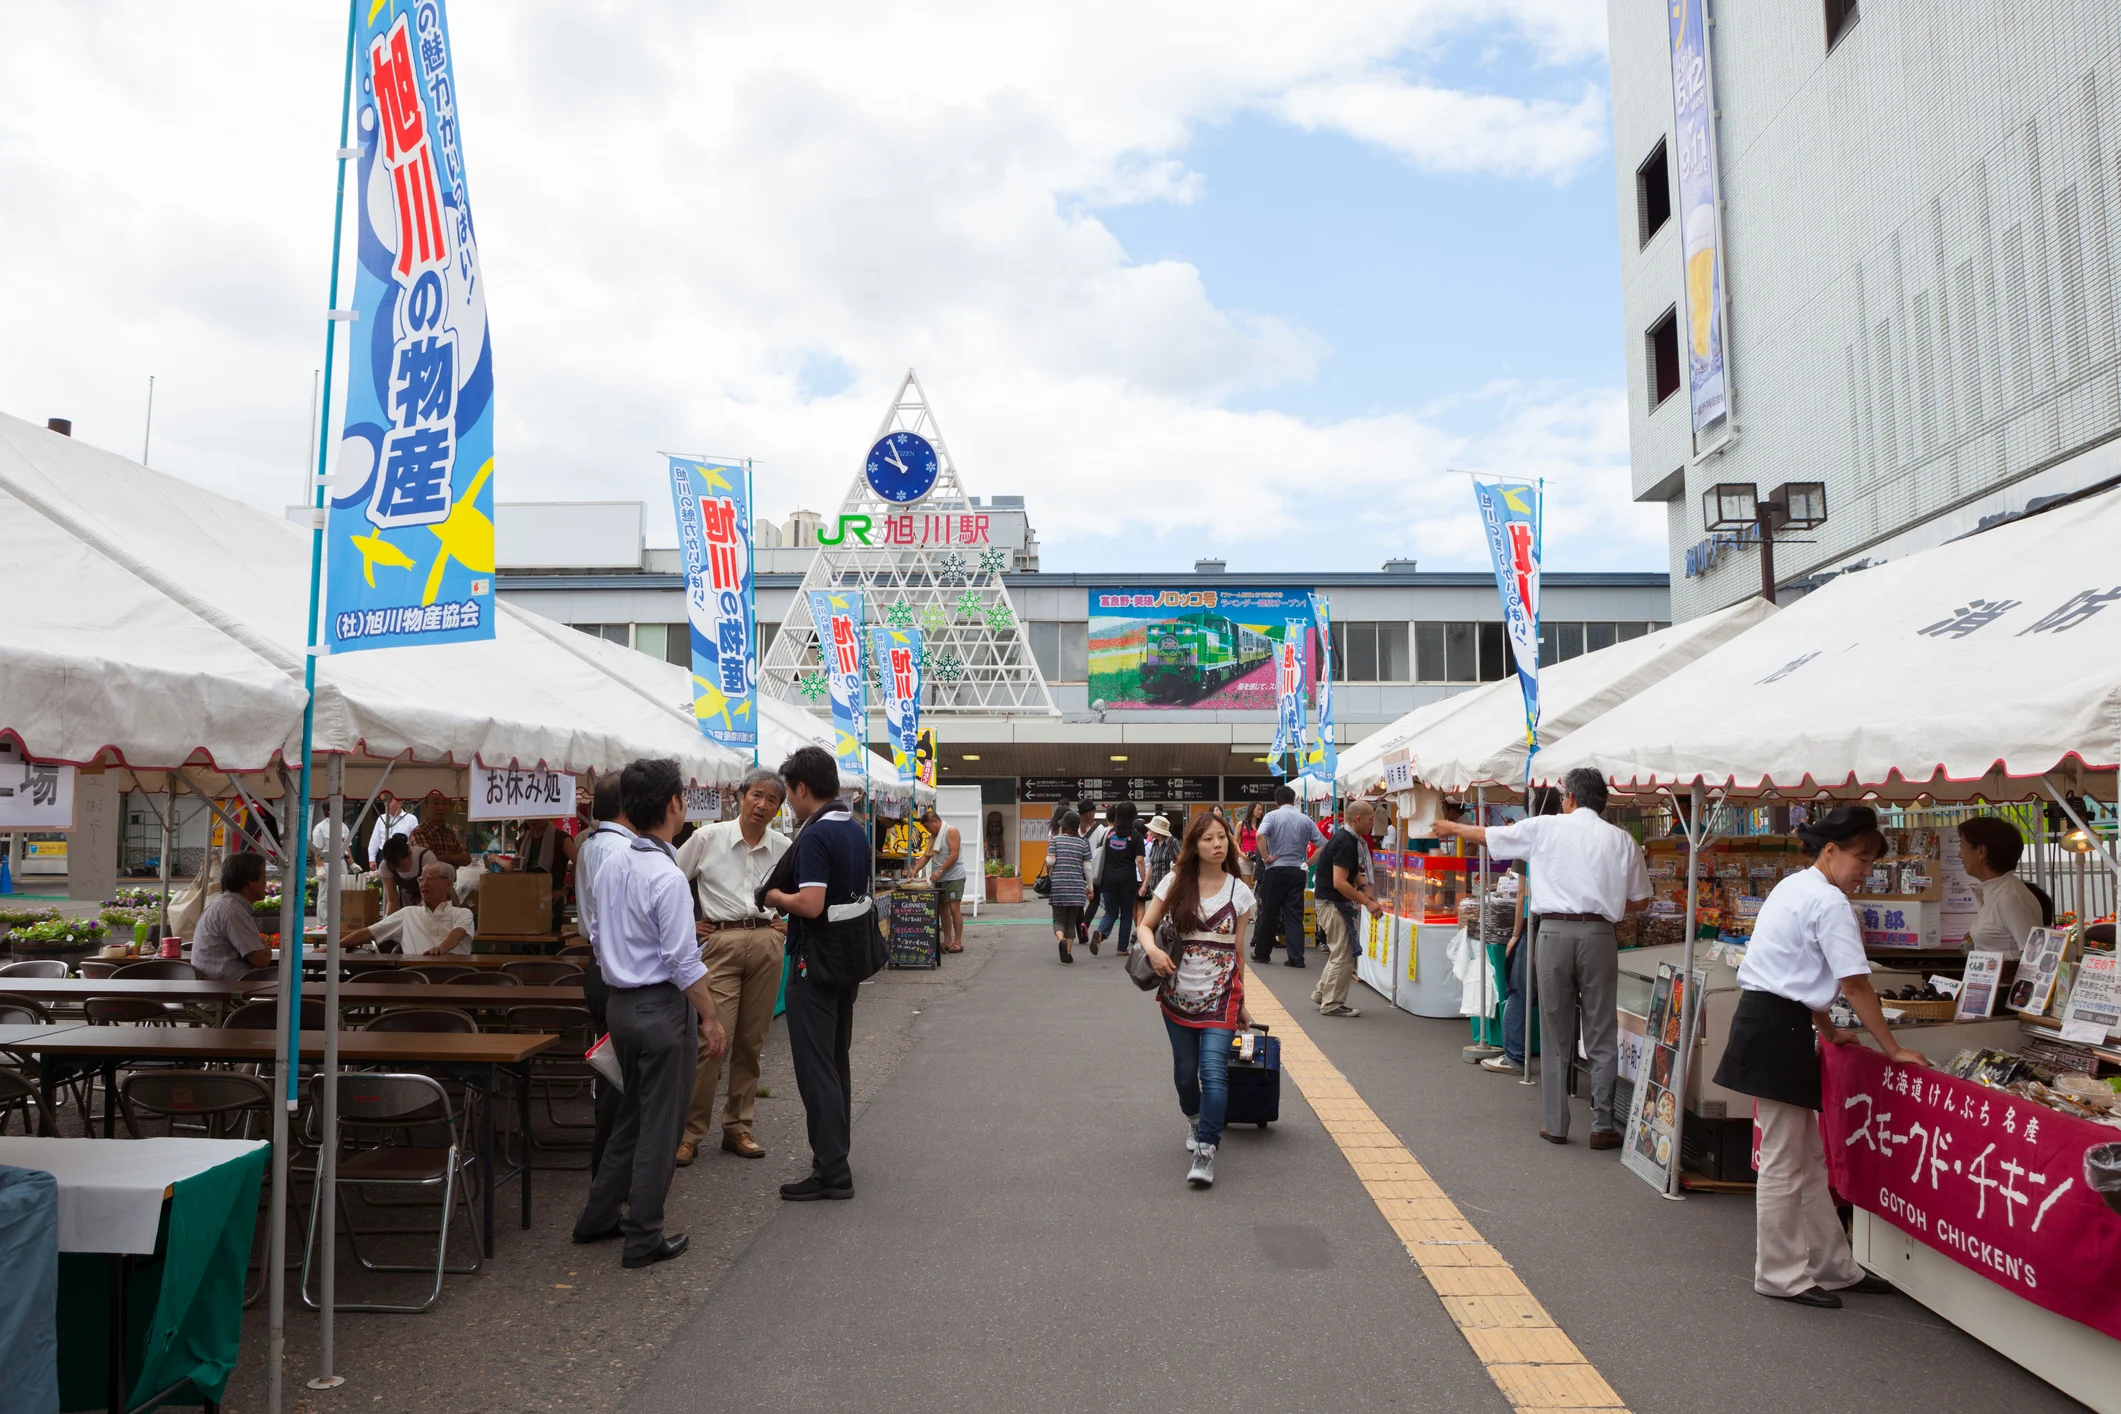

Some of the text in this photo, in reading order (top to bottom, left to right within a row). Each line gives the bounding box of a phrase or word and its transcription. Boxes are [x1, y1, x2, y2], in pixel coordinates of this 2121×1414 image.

[412, 0, 475, 306] の魅力がいっぱい!
[375, 24, 452, 519] 旭川の物産
[817, 515, 872, 546] JR
[884, 515, 990, 545] 旭川駅
[335, 600, 480, 641] (社)旭川物産協会
[486, 768, 561, 805] お休み処
[1845, 1093, 2074, 1233] スモークド・チキン
[1879, 1187, 2037, 1289] GOTOH CHICKEN'S
